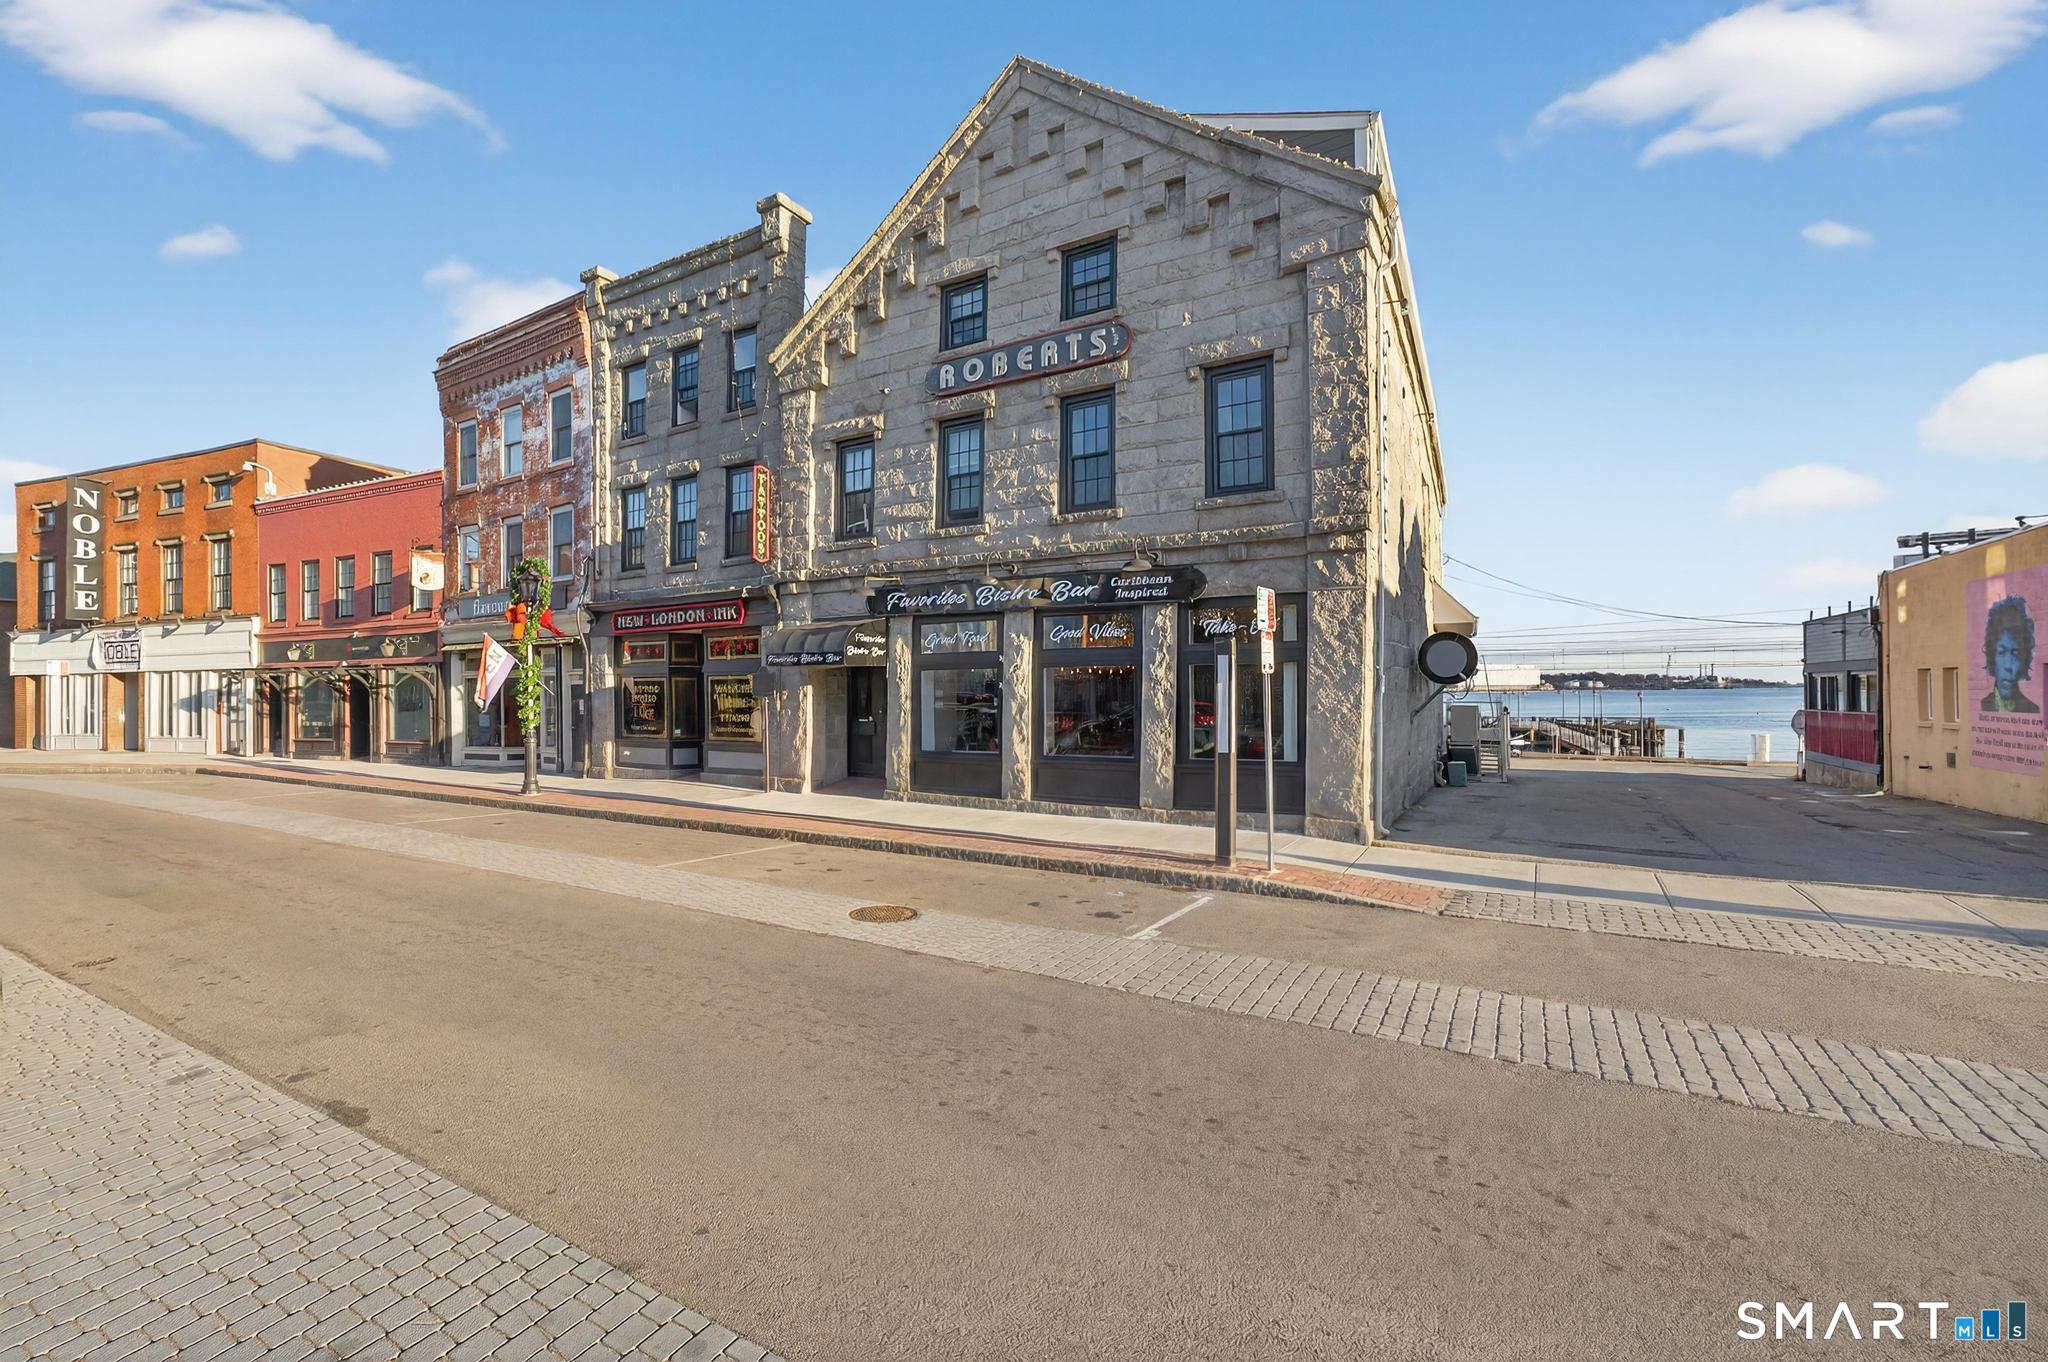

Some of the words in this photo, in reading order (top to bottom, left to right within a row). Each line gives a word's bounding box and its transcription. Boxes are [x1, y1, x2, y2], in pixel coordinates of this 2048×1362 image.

[73, 487, 100, 611] NOBLE
[887, 589, 967, 611] Favorites
[975, 584, 1042, 607] Bistro
[1050, 580, 1099, 602] Bar
[1114, 586, 1168, 600] Inspired
[651, 610, 706, 625] LONDON
[713, 605, 737, 620] INK
